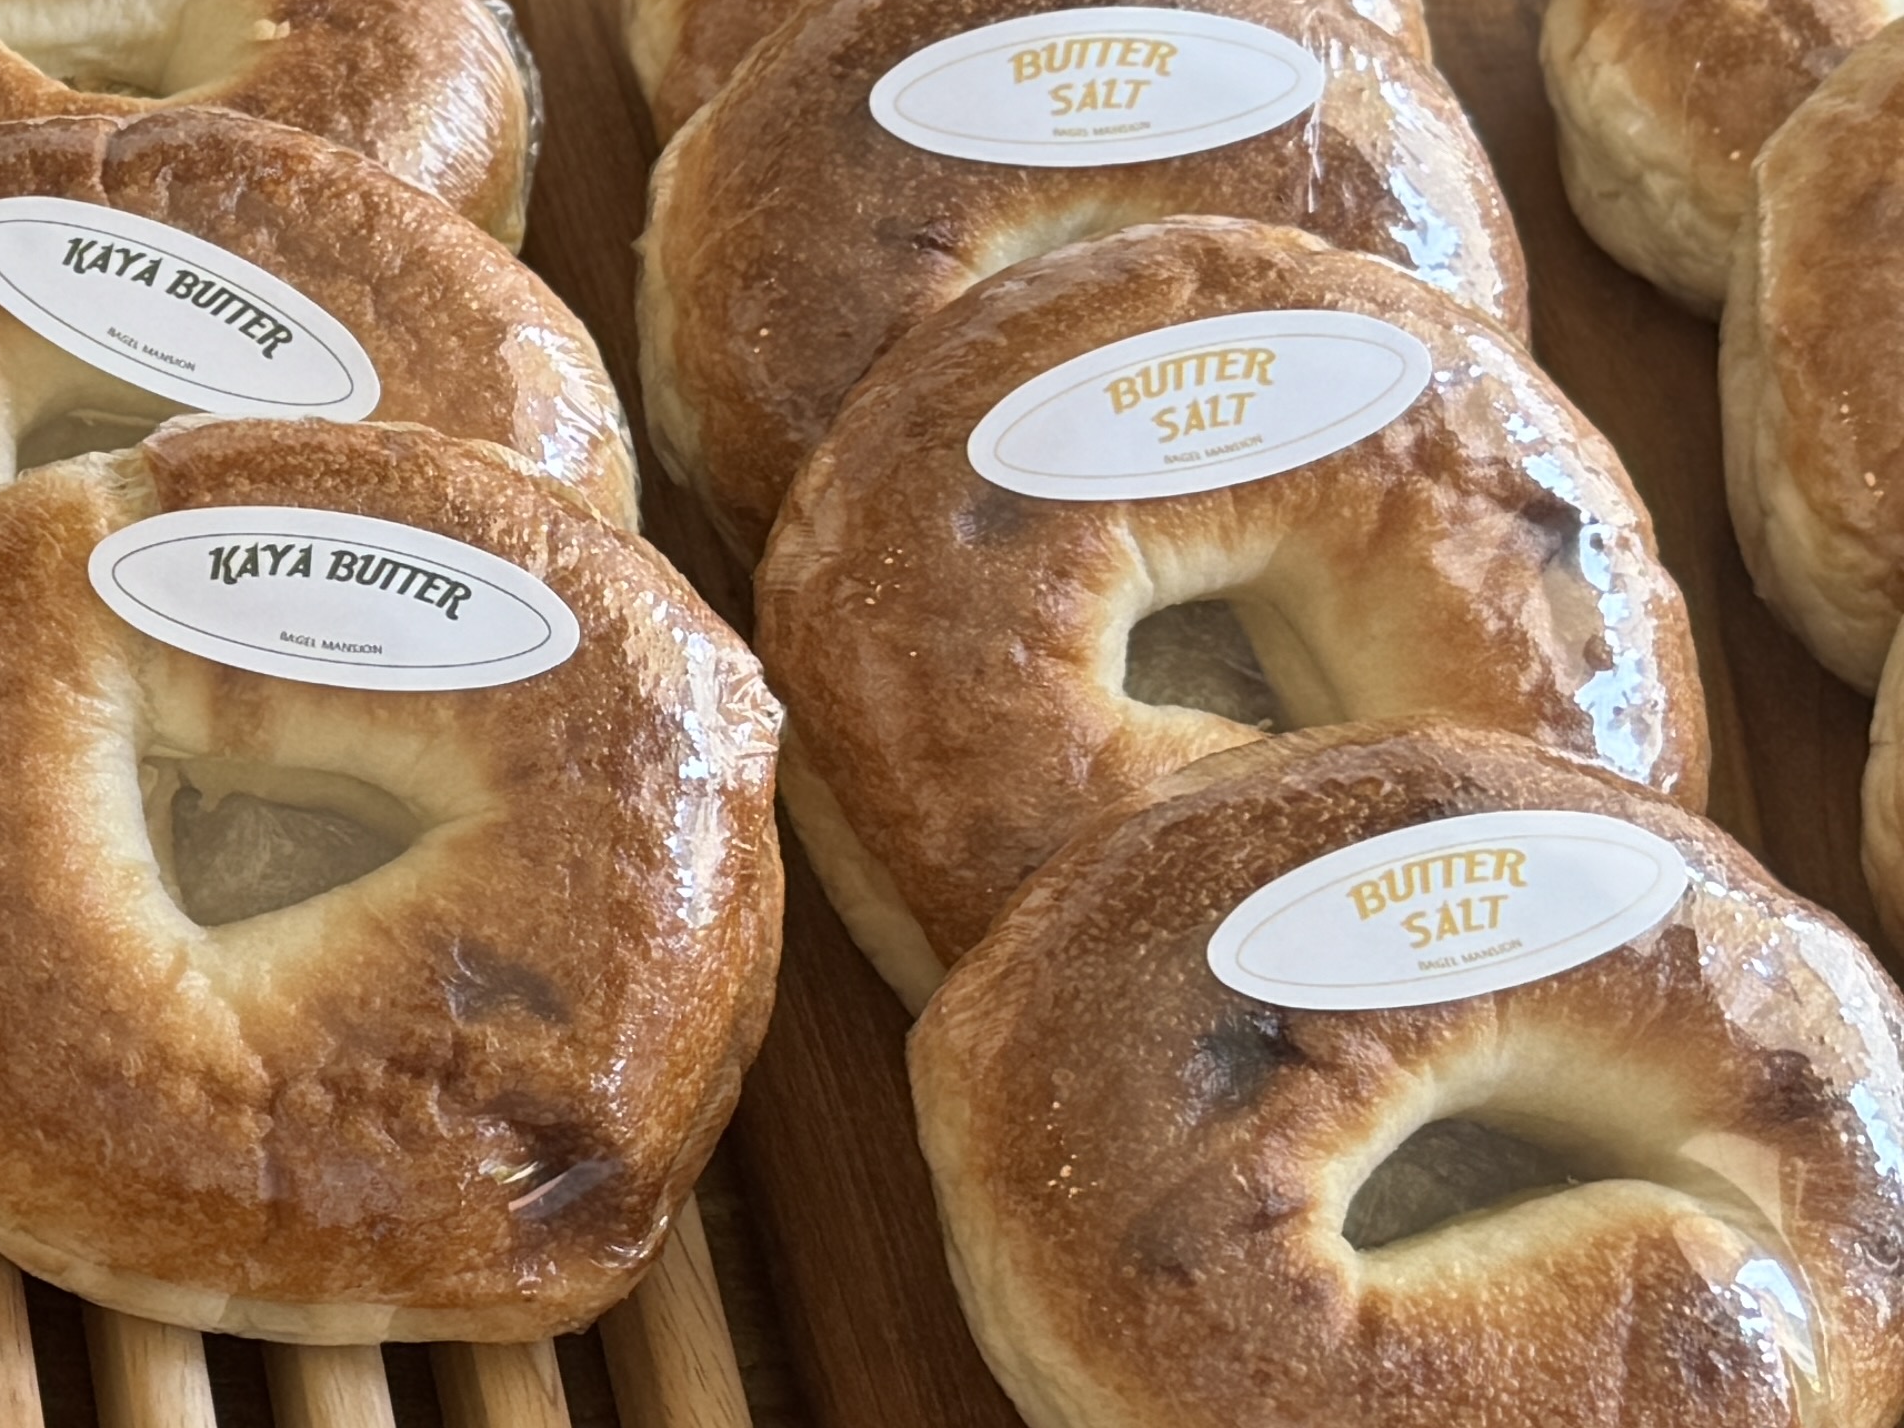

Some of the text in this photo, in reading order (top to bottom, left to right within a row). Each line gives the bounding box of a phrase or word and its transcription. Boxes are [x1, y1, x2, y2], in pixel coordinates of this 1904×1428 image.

[1007, 36, 1179, 85] BUTTER
[1047, 76, 1152, 116] SALT
[60, 235, 294, 360] KAYA BUTTER
[1102, 346, 1278, 416] BUTTER
[1150, 390, 1257, 445] SALT
[208, 541, 473, 621] KAYA BUTTER
[1345, 846, 1528, 922] BUTTER
[1400, 894, 1510, 951] SALT
